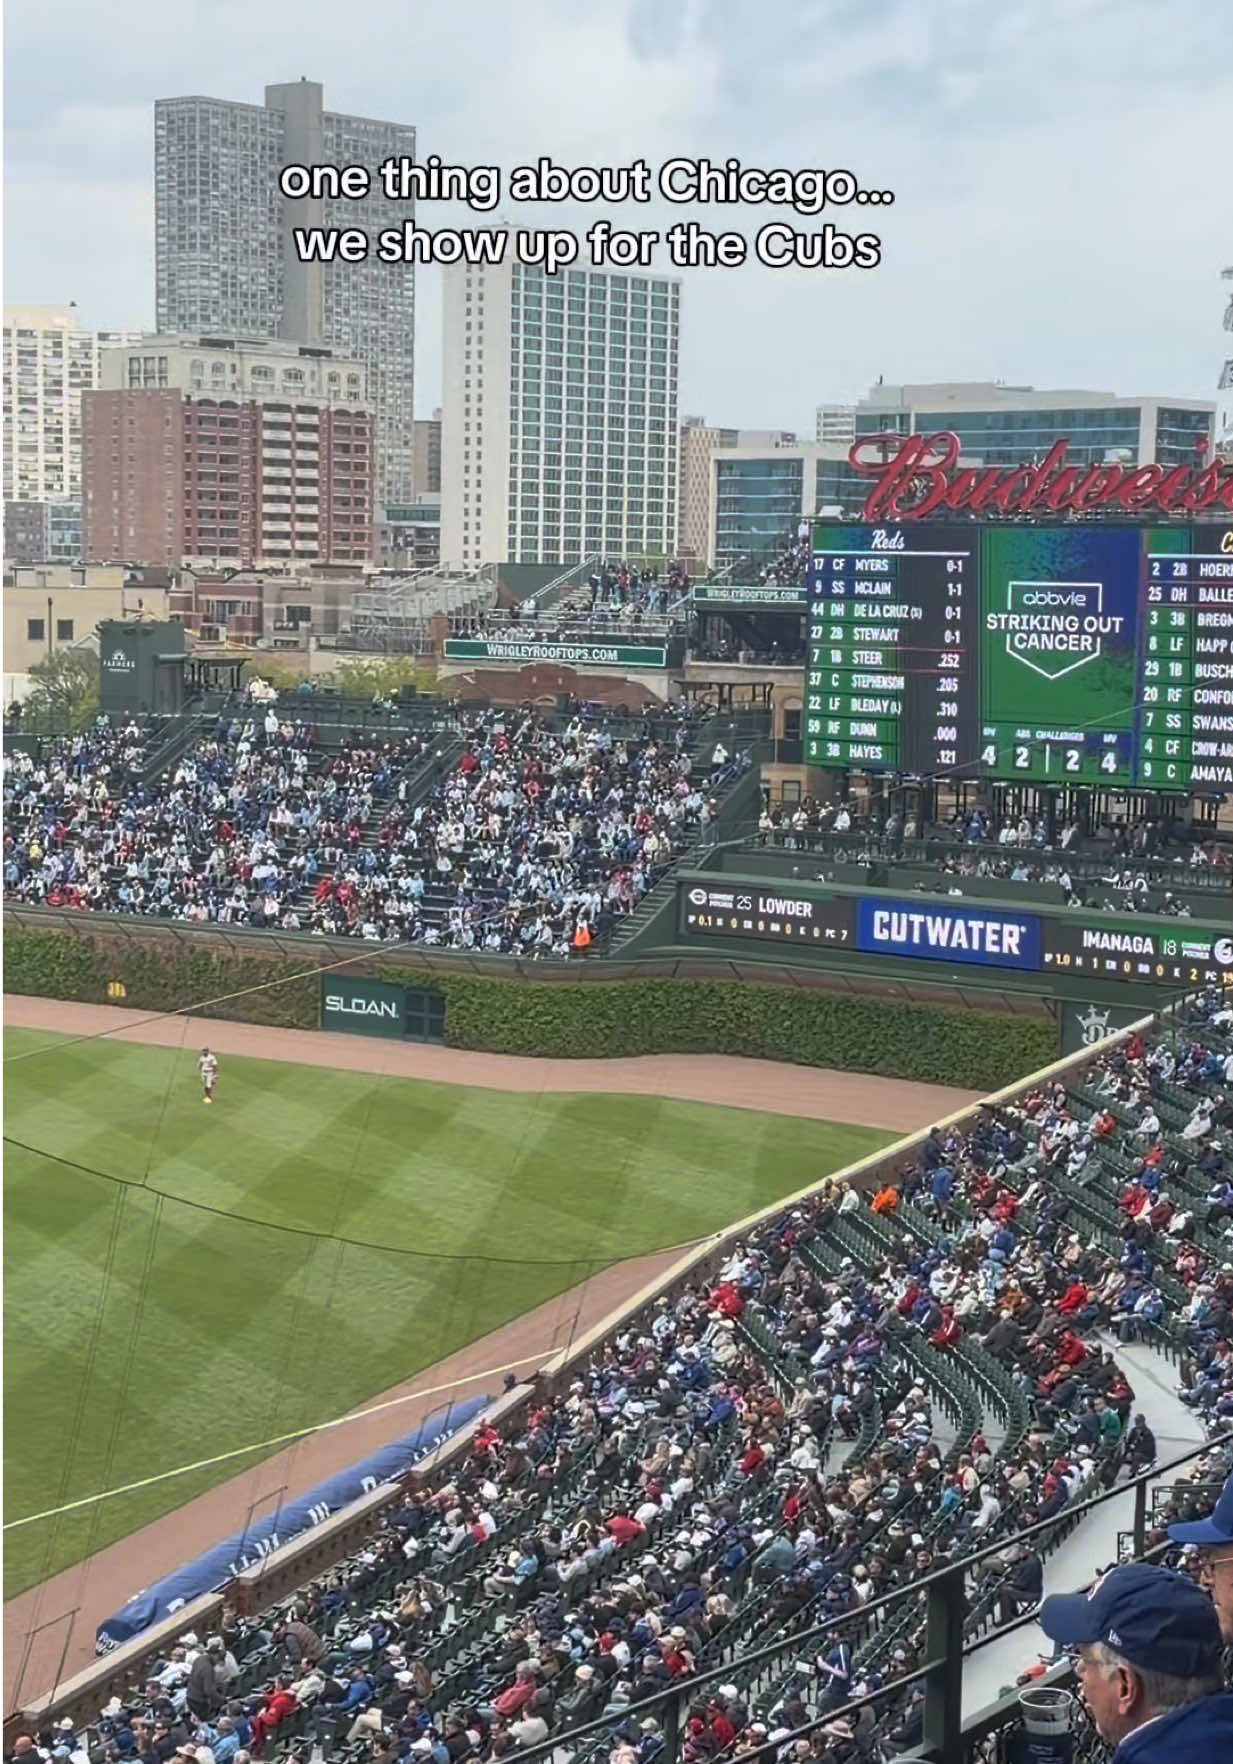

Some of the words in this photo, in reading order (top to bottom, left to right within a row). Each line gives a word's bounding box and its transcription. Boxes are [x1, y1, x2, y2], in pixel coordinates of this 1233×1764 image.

[848, 430, 1233, 522] Budweis
[871, 529, 905, 550] Reds
[814, 559, 824, 571] 17
[833, 559, 845, 571] CF
[855, 559, 889, 571] MYERS
[946, 560, 962, 572] 0-1
[1152, 562, 1160, 576] 2
[1173, 562, 1187, 576] 2B
[815, 581, 822, 594] 9
[832, 581, 845, 594] SS
[854, 582, 891, 595] MCLAIN
[948, 584, 962, 596] 1-1
[1148, 586, 1162, 601] 25
[1171, 587, 1187, 602] DH
[1023, 592, 1087, 607] abbvie
[811, 603, 824, 616] 44
[830, 604, 844, 617] DH
[854, 605, 867, 617] DE
[869, 605, 880, 617] LA
[883, 606, 909, 618] CRUZ
[945, 607, 961, 620] 0-1
[1150, 611, 1159, 625] 3
[1170, 612, 1185, 626] 3B
[986, 614, 1080, 633] STRIKING
[1084, 616, 1124, 633] OUT
[811, 626, 822, 638] 27
[853, 628, 900, 642] STEWART
[944, 630, 960, 643] 0-1
[1014, 633, 1093, 651] CANCER
[487, 643, 618, 661] WRIGLEYROOFTOPS.COM
[1170, 637, 1184, 651] LF
[1196, 638, 1227, 652] HAPP
[813, 649, 819, 662] 7
[852, 650, 882, 665] STEER
[938, 654, 960, 668] .252
[1144, 661, 1159, 676] 29
[1195, 664, 1233, 678] BUSCH
[809, 673, 822, 685] 37
[831, 674, 839, 686] C
[936, 678, 958, 691] .205
[1144, 686, 1158, 701] 20
[1167, 688, 1182, 702] RF
[1194, 690, 1233, 705] CONFO
[808, 696, 821, 709] 22
[829, 697, 840, 710] LF
[850, 699, 889, 713] BLEDAY
[937, 702, 957, 716] .310
[828, 720, 840, 734] RF
[850, 722, 877, 737] DUNN
[934, 726, 956, 741] .000
[1146, 712, 1154, 727] 7
[1166, 714, 1182, 728] SS
[1192, 715, 1233, 731] SWANS
[810, 743, 817, 755] 3
[827, 743, 840, 757] 3B
[849, 745, 882, 760] HAYES
[1144, 738, 1152, 753] 4
[1166, 740, 1180, 754] CF
[981, 745, 996, 765] 4
[1016, 746, 1029, 767] 2
[1066, 750, 1079, 771] 2
[1101, 752, 1117, 773] 4
[1144, 762, 1151, 777] 9
[1167, 764, 1175, 778] C
[1190, 765, 1232, 782] AMAYA
[737, 895, 752, 910] 25
[759, 897, 812, 918] LOWDER
[698, 914, 712, 926] 0.1
[840, 930, 848, 940] 7
[1083, 930, 1154, 955] IMANAGA
[1163, 940, 1177, 956] 18
[1056, 954, 1071, 966] 1.0
[1092, 958, 1098, 969] 1
[1124, 961, 1131, 972] 0
[1156, 965, 1164, 976] 0
[1190, 968, 1197, 980] 2
[325, 995, 396, 1018] SLOAN
